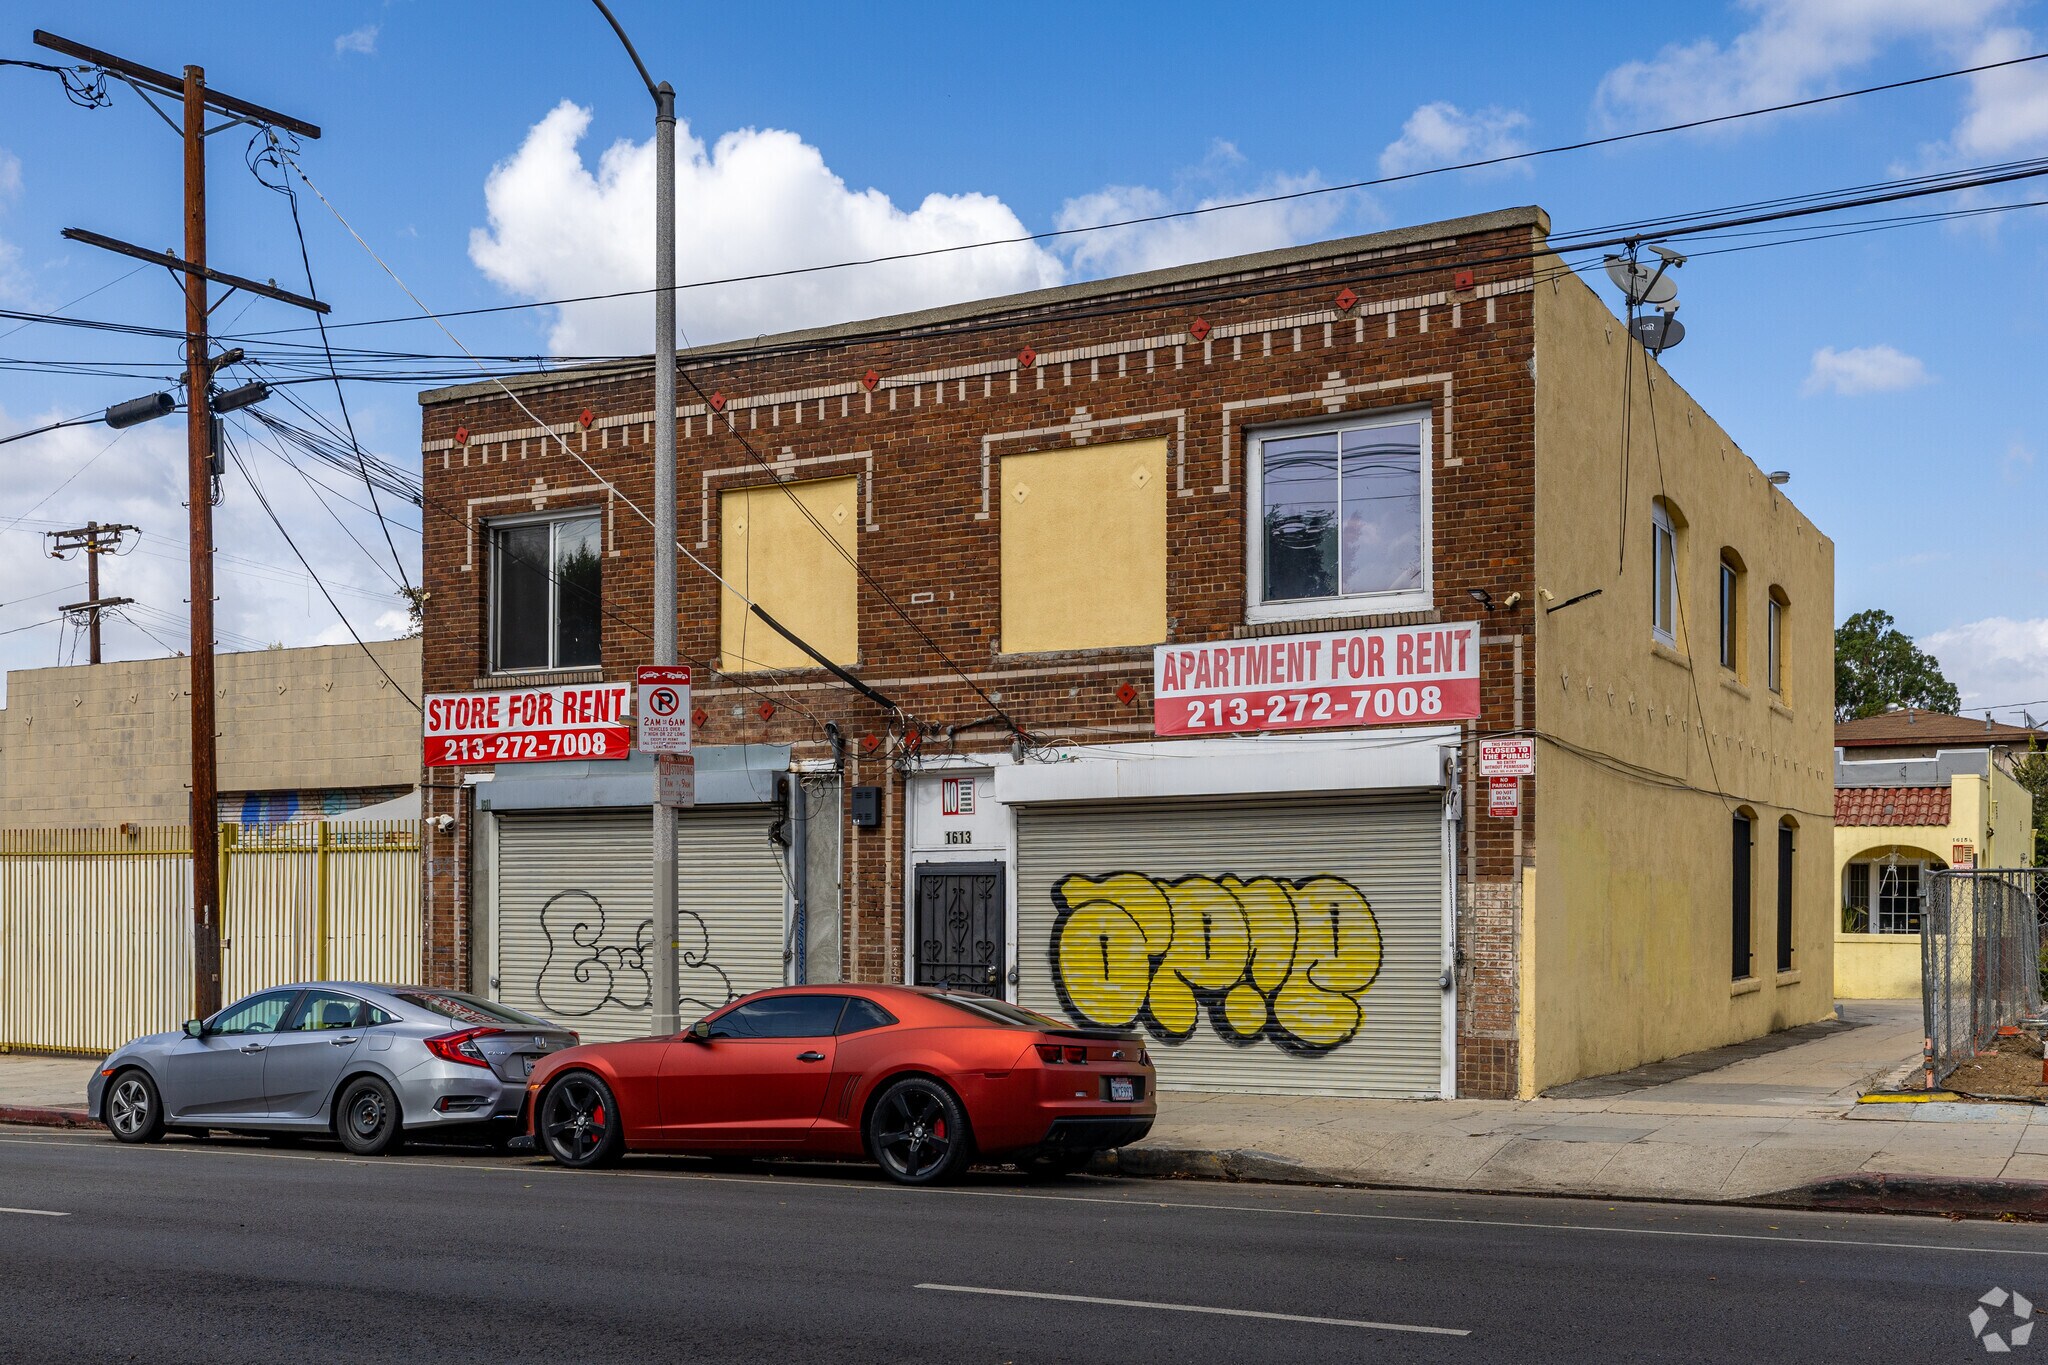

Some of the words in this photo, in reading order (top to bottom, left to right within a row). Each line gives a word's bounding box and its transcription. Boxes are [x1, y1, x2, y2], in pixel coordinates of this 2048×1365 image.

[1161, 640, 1321, 692] APARTMENT
[1331, 636, 1385, 680] FOR
[1396, 629, 1471, 675] RENT
[428, 696, 500, 732] STORE
[508, 692, 553, 727] FOR
[563, 688, 626, 724] RENT
[644, 717, 661, 726] 2AM
[669, 717, 685, 726] 6AM
[1187, 685, 1442, 728] 213-272-7008
[445, 732, 607, 761] 213-272-7008
[661, 762, 670, 775] NO
[944, 781, 957, 813] NO
[946, 831, 971, 844] 1613
